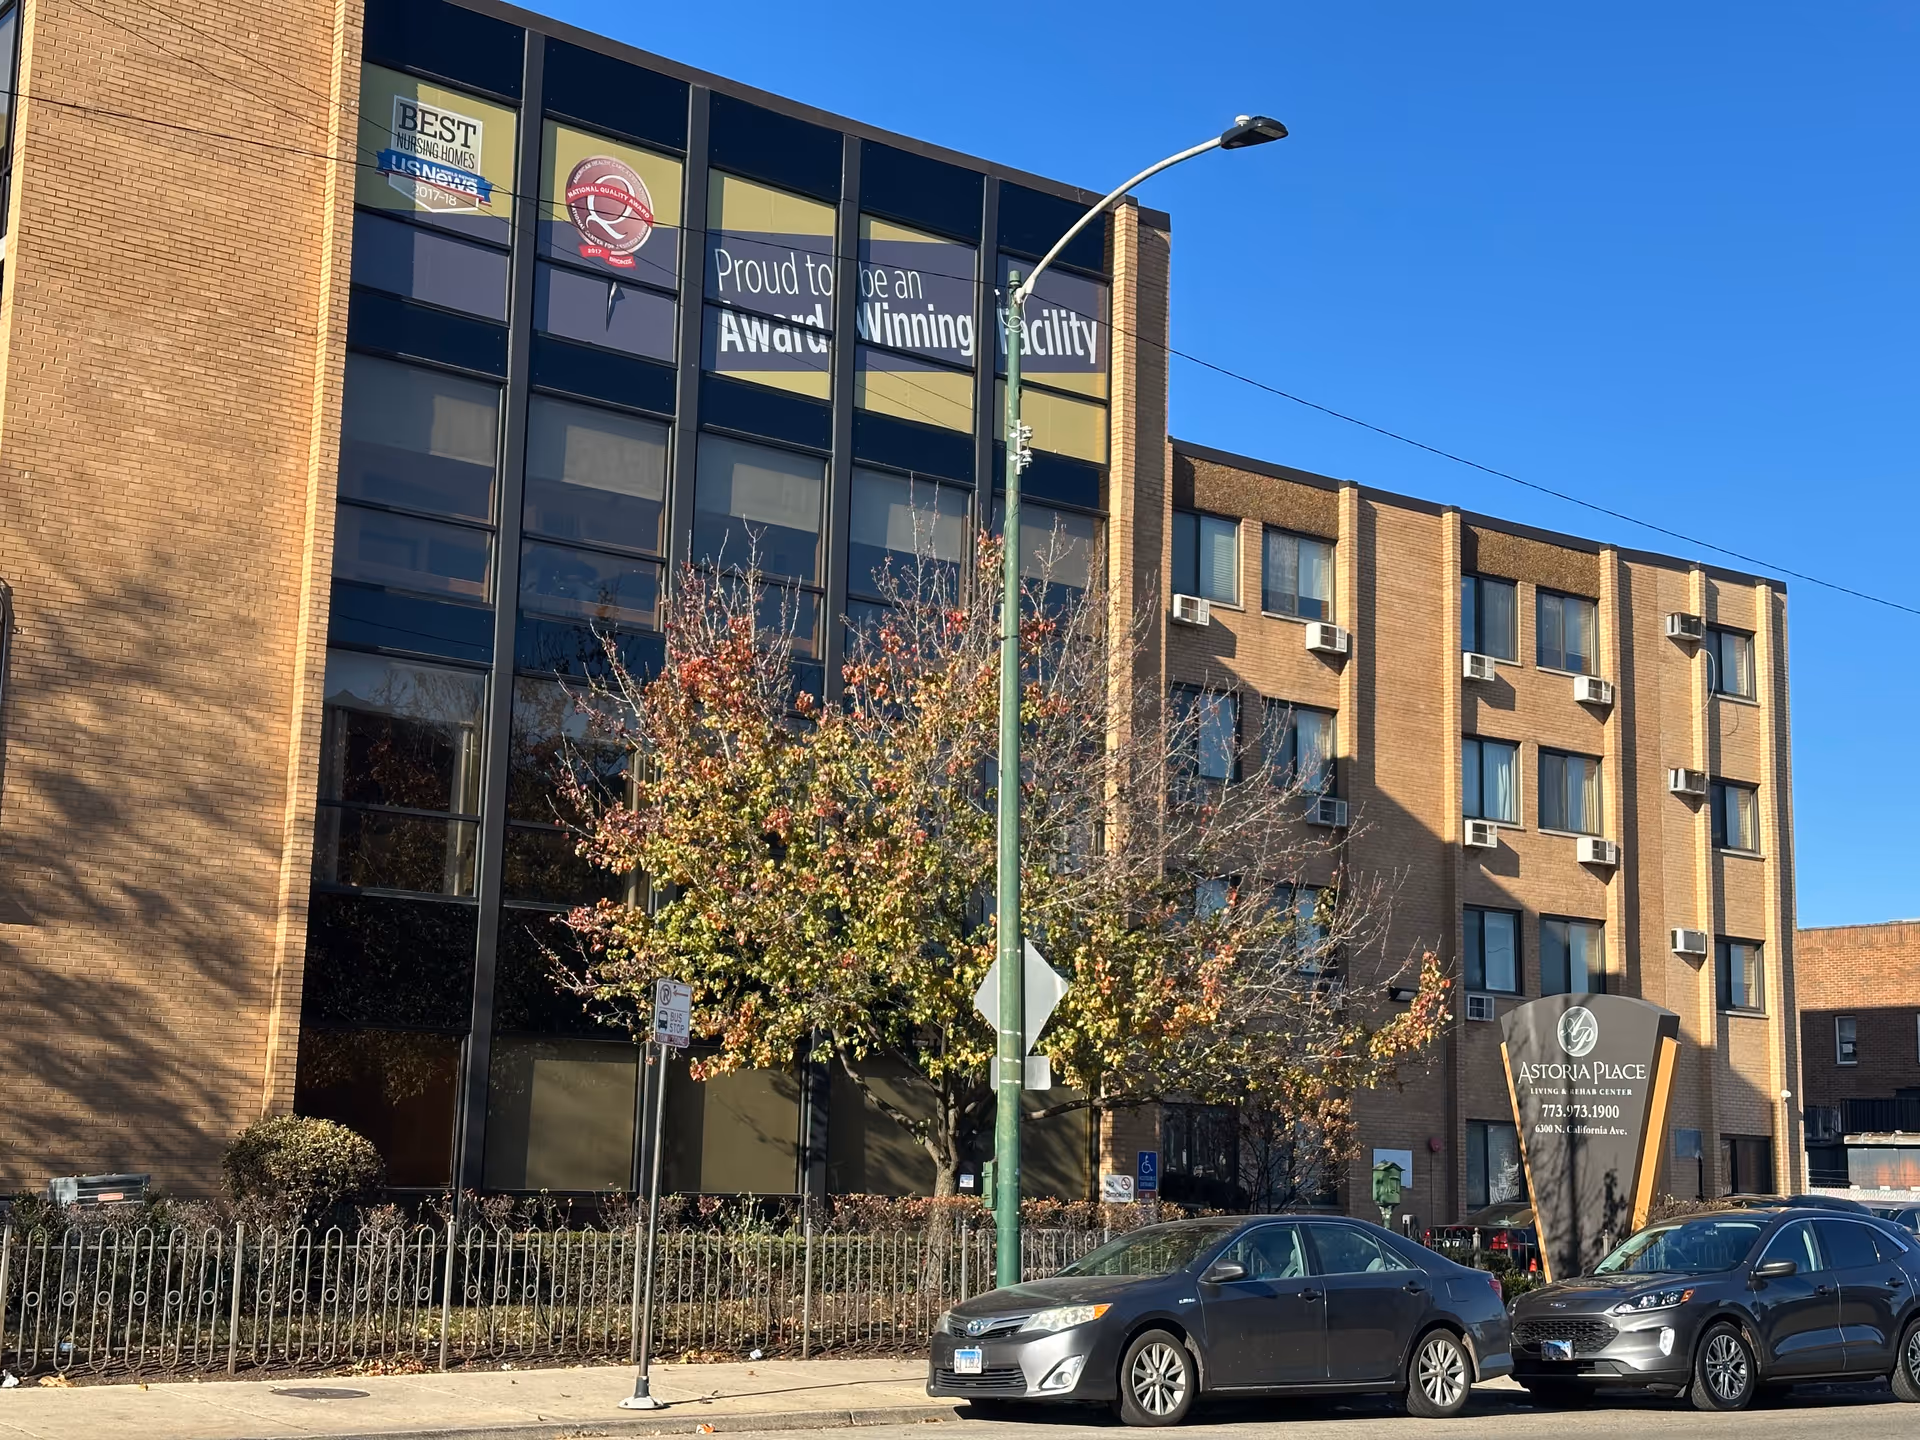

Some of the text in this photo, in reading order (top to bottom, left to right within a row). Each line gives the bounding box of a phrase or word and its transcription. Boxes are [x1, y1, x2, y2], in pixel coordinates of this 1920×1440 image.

[399, 102, 477, 149] BEST
[397, 132, 475, 170] NURSING HOMES
[411, 184, 457, 206] 2017-18
[567, 186, 650, 219] NATIONAL QUALITY AWARD
[714, 248, 923, 300] Proud to be an
[856, 301, 975, 357] Winning
[670, 1012, 683, 1023] BUS
[670, 1023, 685, 1033] STOP
[1518, 1061, 1647, 1084] ASTORIA PLACE
[1599, 1088, 1633, 1096] CENTER
[1541, 1104, 1620, 1119] 773.973.1900
[1535, 1124, 1628, 1136] 6300 N. California Ave.
[1106, 1191, 1131, 1200] Smoking
